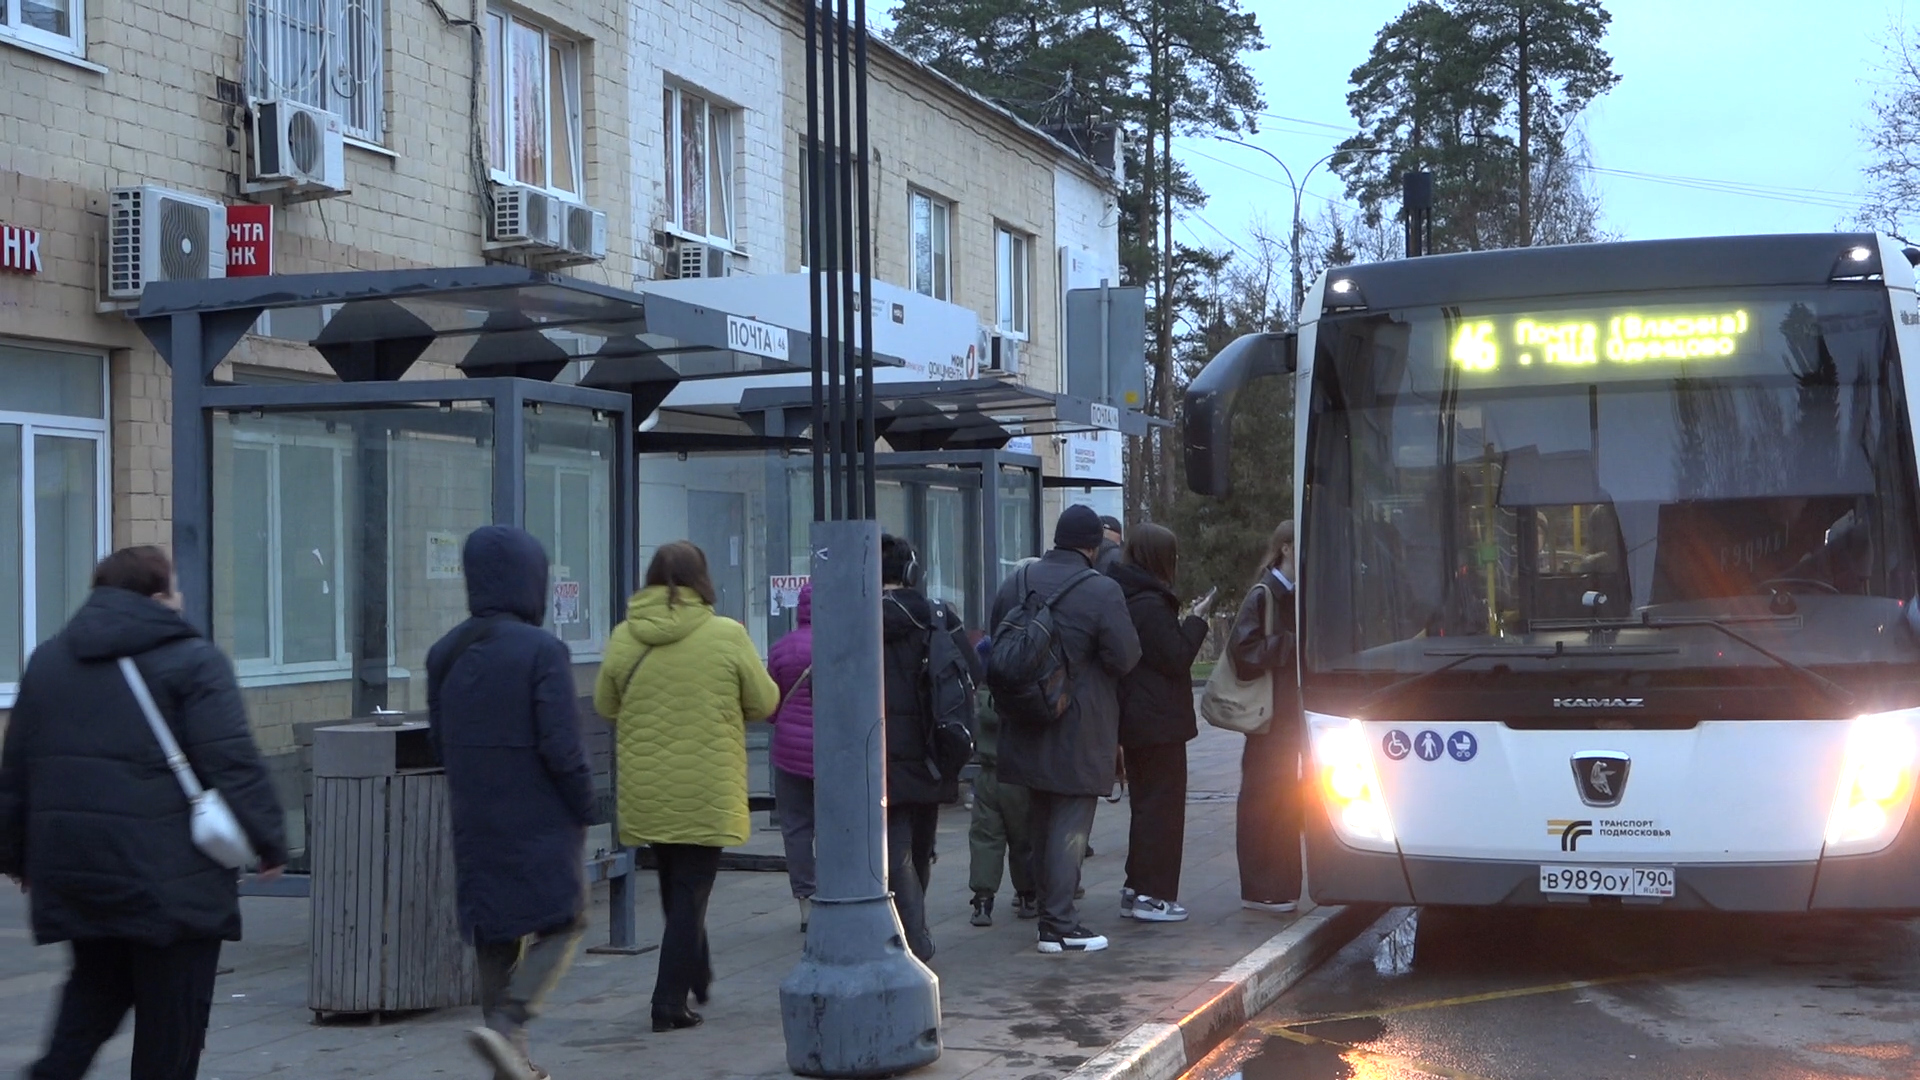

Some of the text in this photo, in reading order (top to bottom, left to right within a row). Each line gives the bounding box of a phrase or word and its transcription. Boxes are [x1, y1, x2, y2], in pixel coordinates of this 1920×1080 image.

[730, 320, 773, 353] ПОЧТА
[1452, 321, 1498, 371] 46
[772, 577, 811, 589] КУПЛ
[1553, 698, 1644, 708] KAMAZ
[1599, 820, 1654, 828] ТРАНСПОРТ
[1599, 829, 1671, 837] ПОДМОСКОВЬЯ
[1635, 870, 1668, 887] 790
